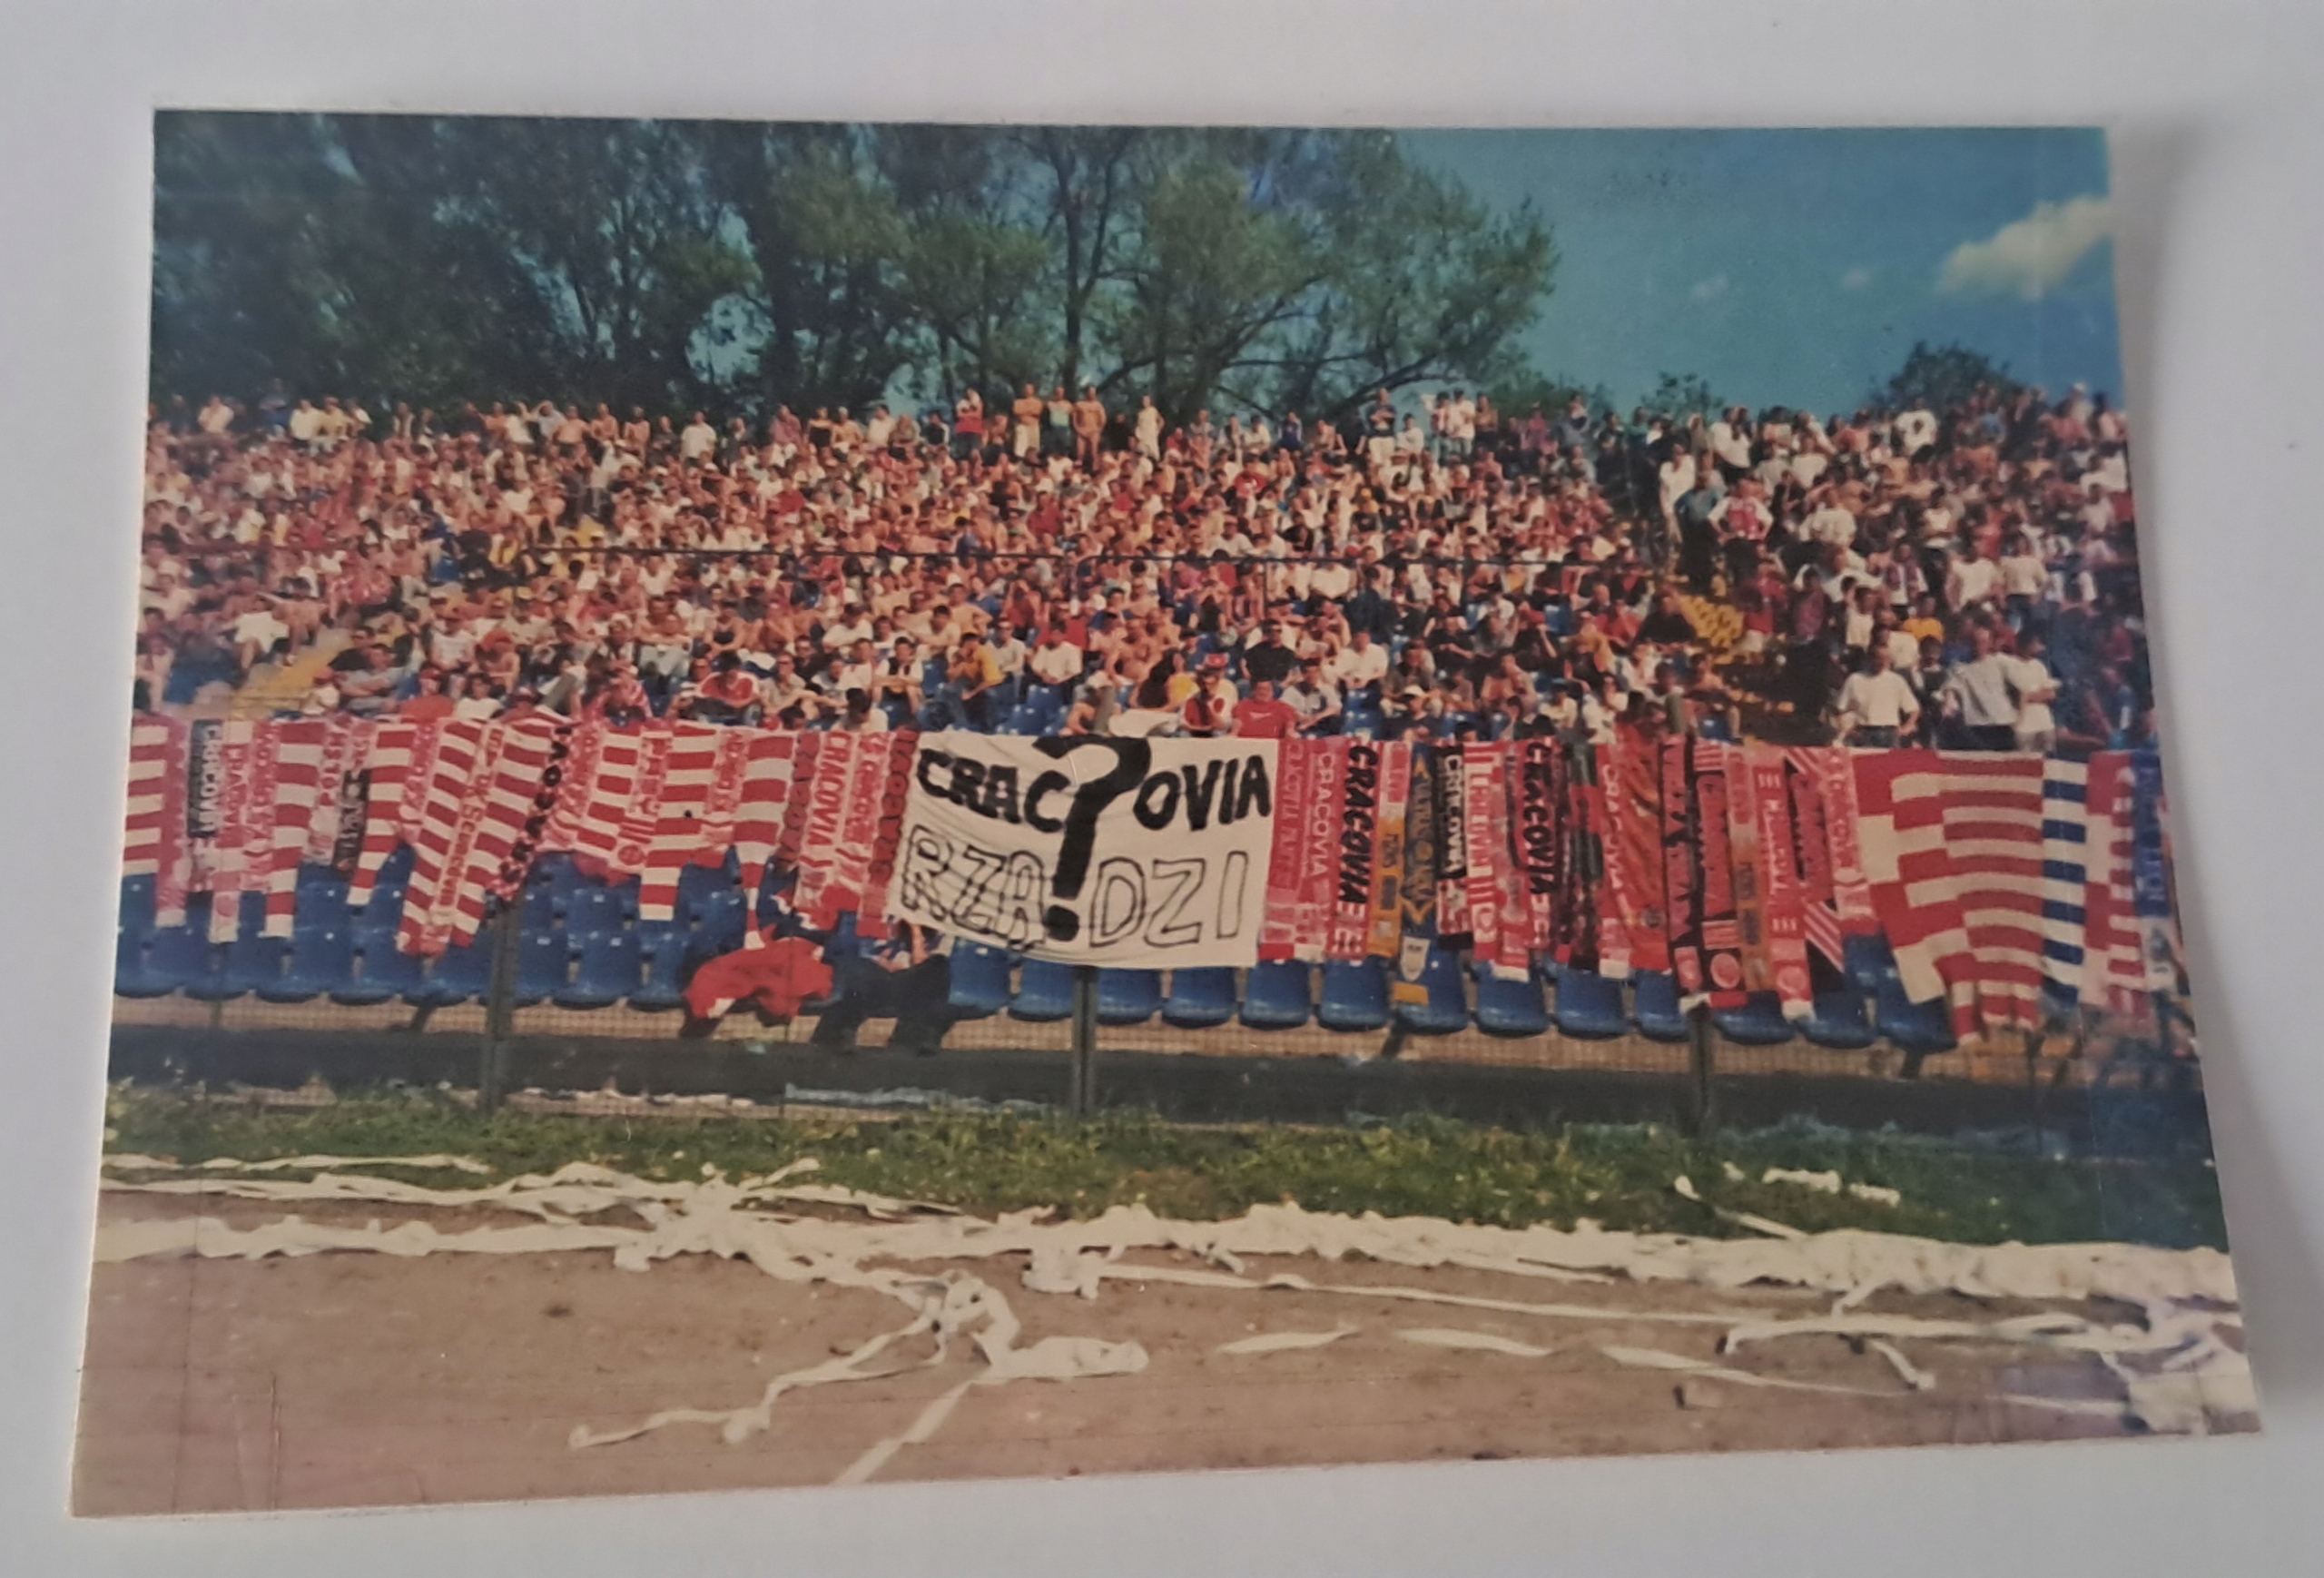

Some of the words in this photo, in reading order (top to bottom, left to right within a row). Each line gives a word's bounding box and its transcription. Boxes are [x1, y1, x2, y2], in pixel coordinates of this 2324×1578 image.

[807, 731, 852, 846] CRACOVIA
[1338, 745, 1378, 903] CRACOVIA
[1522, 742, 1555, 893] CRACOVIA
